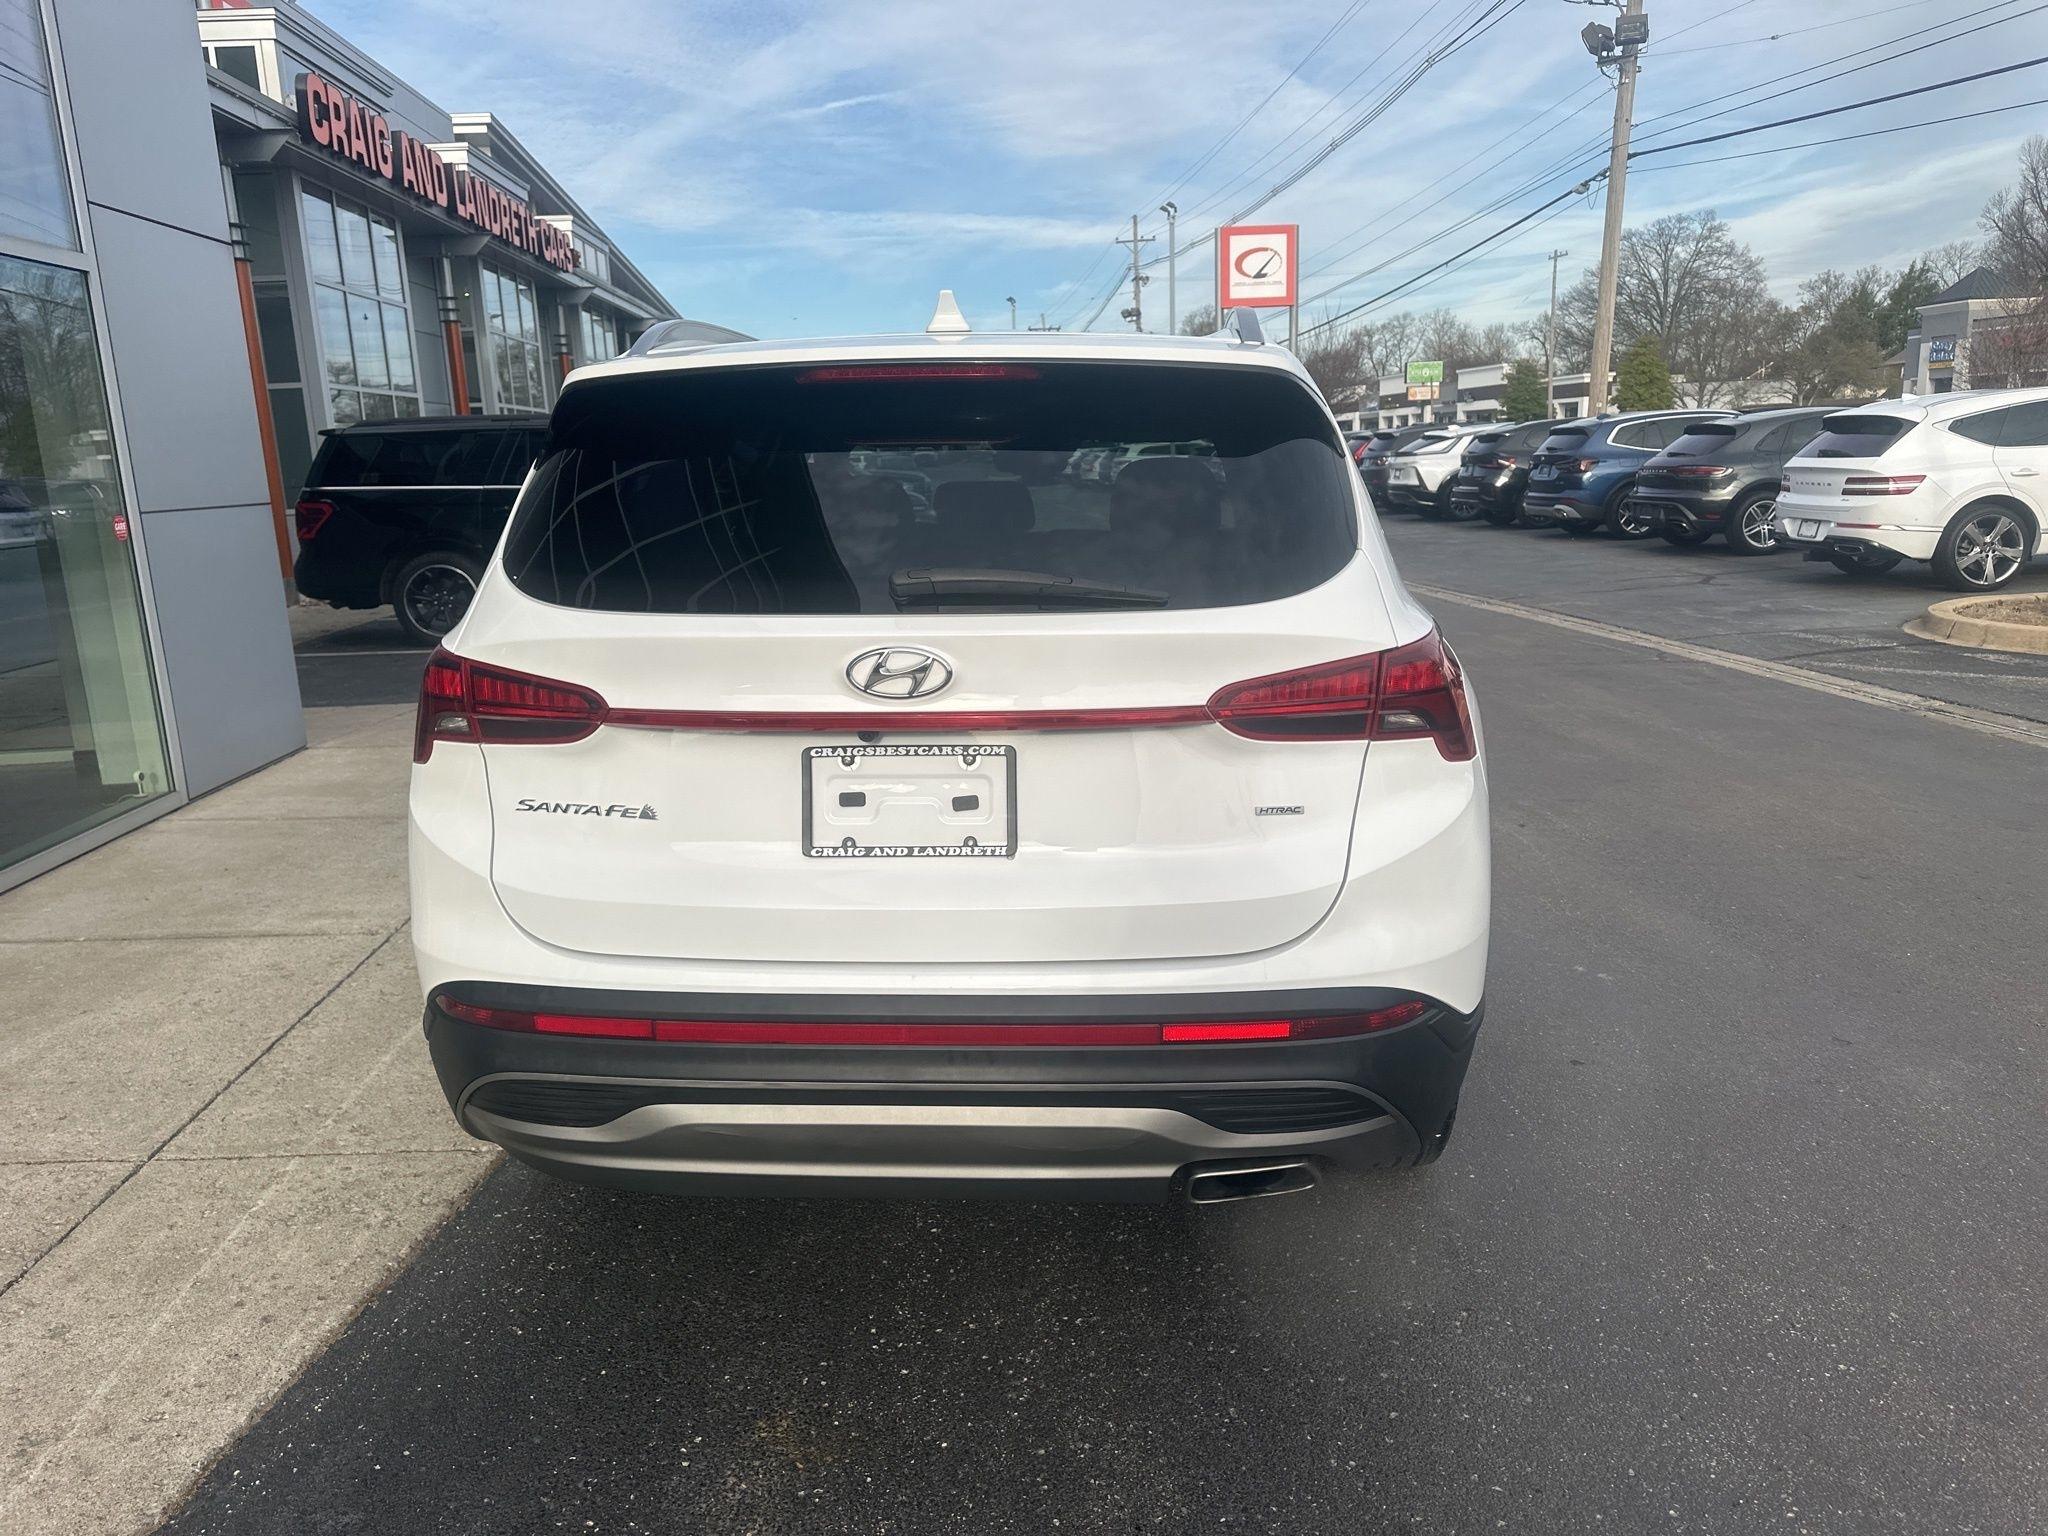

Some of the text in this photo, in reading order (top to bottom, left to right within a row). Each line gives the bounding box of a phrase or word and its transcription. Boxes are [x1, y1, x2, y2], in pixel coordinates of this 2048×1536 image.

[305, 72, 574, 273] CRAIG AND LANDRETH CARS
[809, 745, 1006, 757] CRAIGSBESTCARS.COM
[1259, 805, 1302, 815] HTRAC
[810, 845, 1008, 857] CRAIG AND LANDRETH
